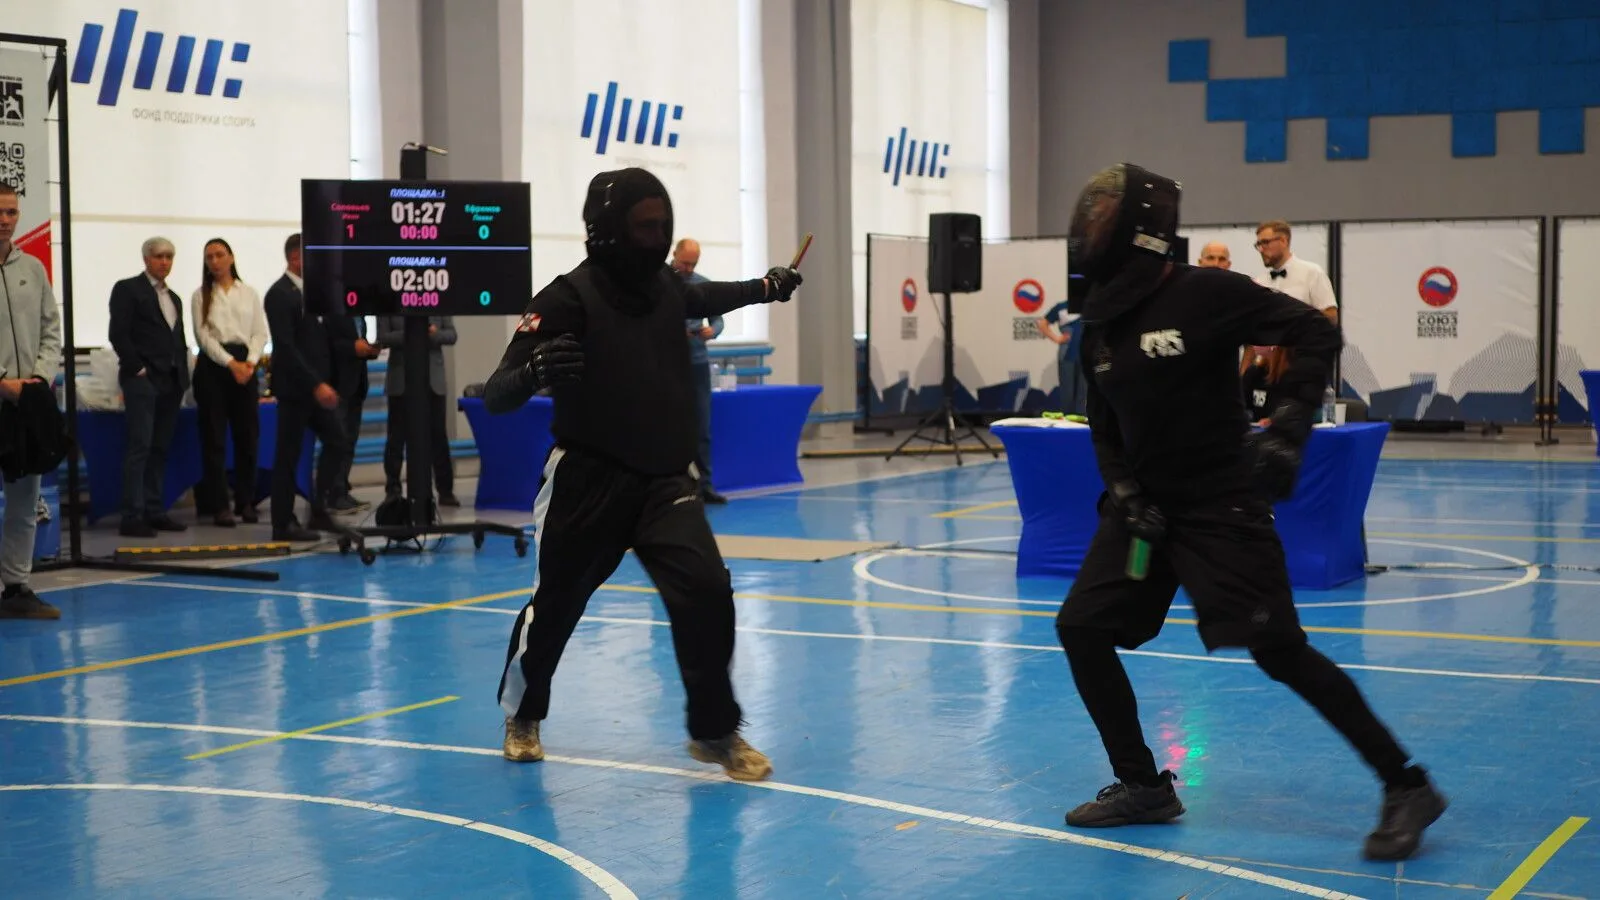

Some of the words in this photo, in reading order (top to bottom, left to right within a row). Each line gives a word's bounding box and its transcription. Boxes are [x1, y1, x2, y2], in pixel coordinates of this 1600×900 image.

[131, 107, 161, 122] ФОНД
[163, 110, 220, 125] ПОДДЕРЖКИ
[222, 115, 256, 128] СПОРТА
[390, 188, 437, 199] ПЛОЩАДКА
[391, 201, 446, 225] 01:27
[346, 223, 354, 239] 1
[400, 224, 438, 240] 00:00
[478, 224, 490, 240] 0
[388, 256, 436, 267] ПЛОЩАДКА
[390, 268, 450, 292] 02:00
[346, 291, 358, 307] 0
[401, 291, 439, 307] 00:00
[479, 290, 491, 306] 0
[1417, 315, 1458, 325] СОЮЗ
